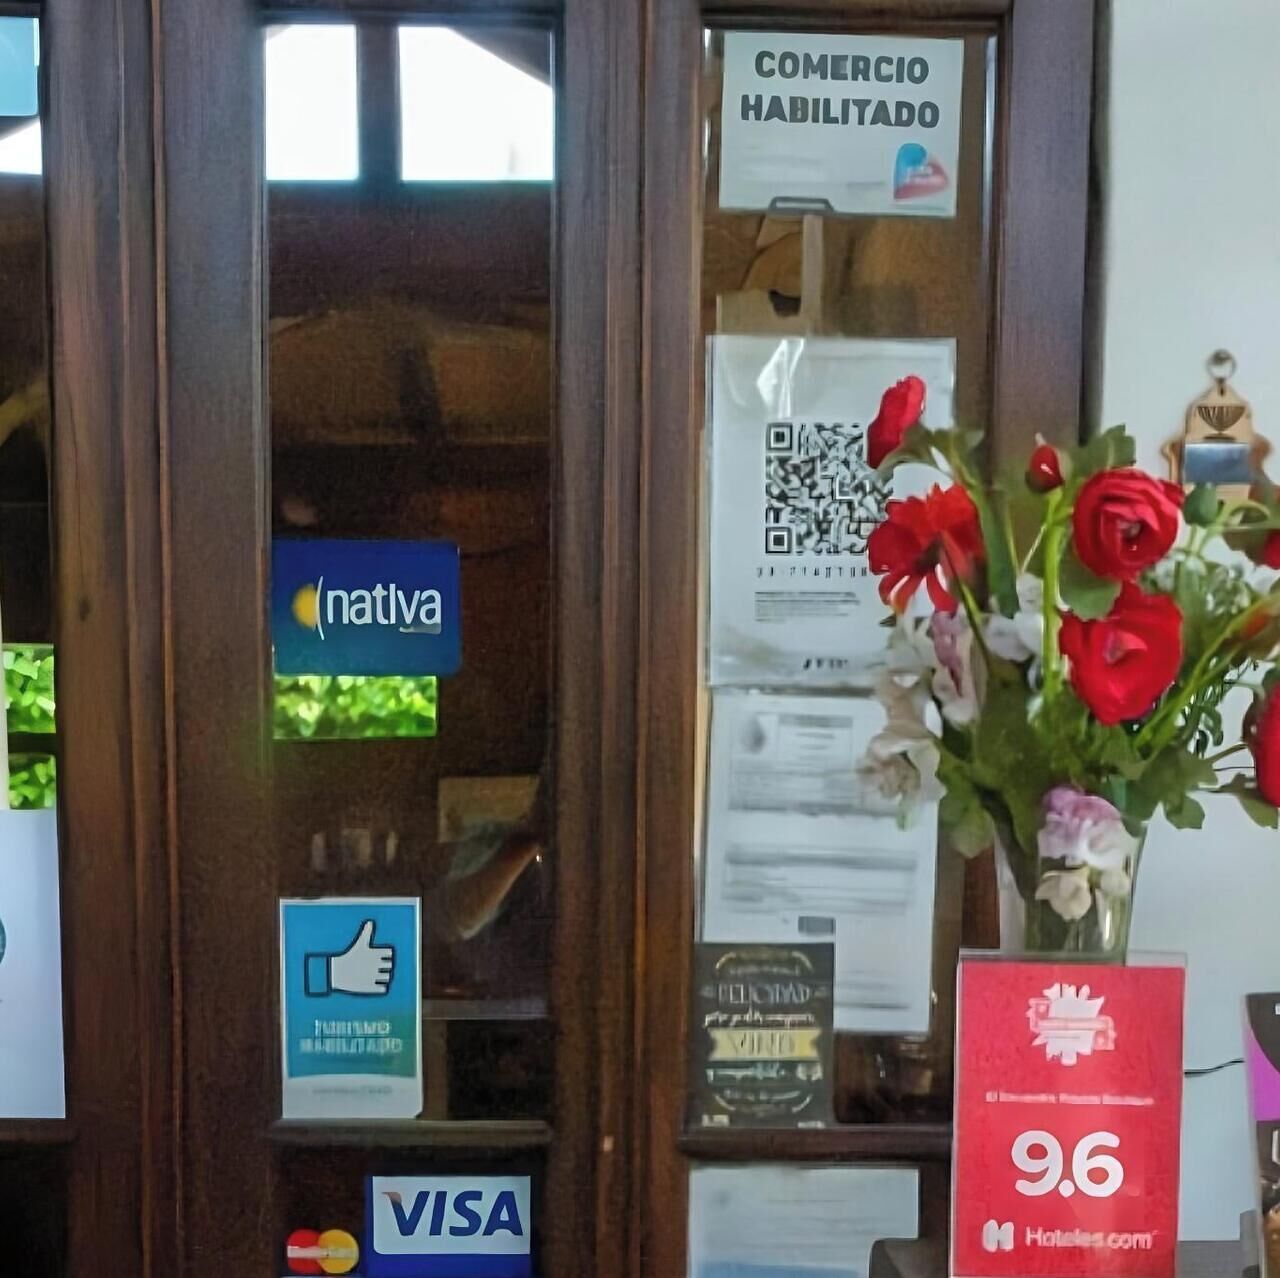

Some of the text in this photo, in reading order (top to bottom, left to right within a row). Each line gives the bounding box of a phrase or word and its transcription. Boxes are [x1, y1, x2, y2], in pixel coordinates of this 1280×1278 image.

[754, 50, 930, 84] COMERCIO
[740, 94, 940, 129] HABILITADO
[327, 583, 442, 625] nativa
[1011, 1129, 1124, 1198] 9.6
[381, 1190, 524, 1237] VISA
